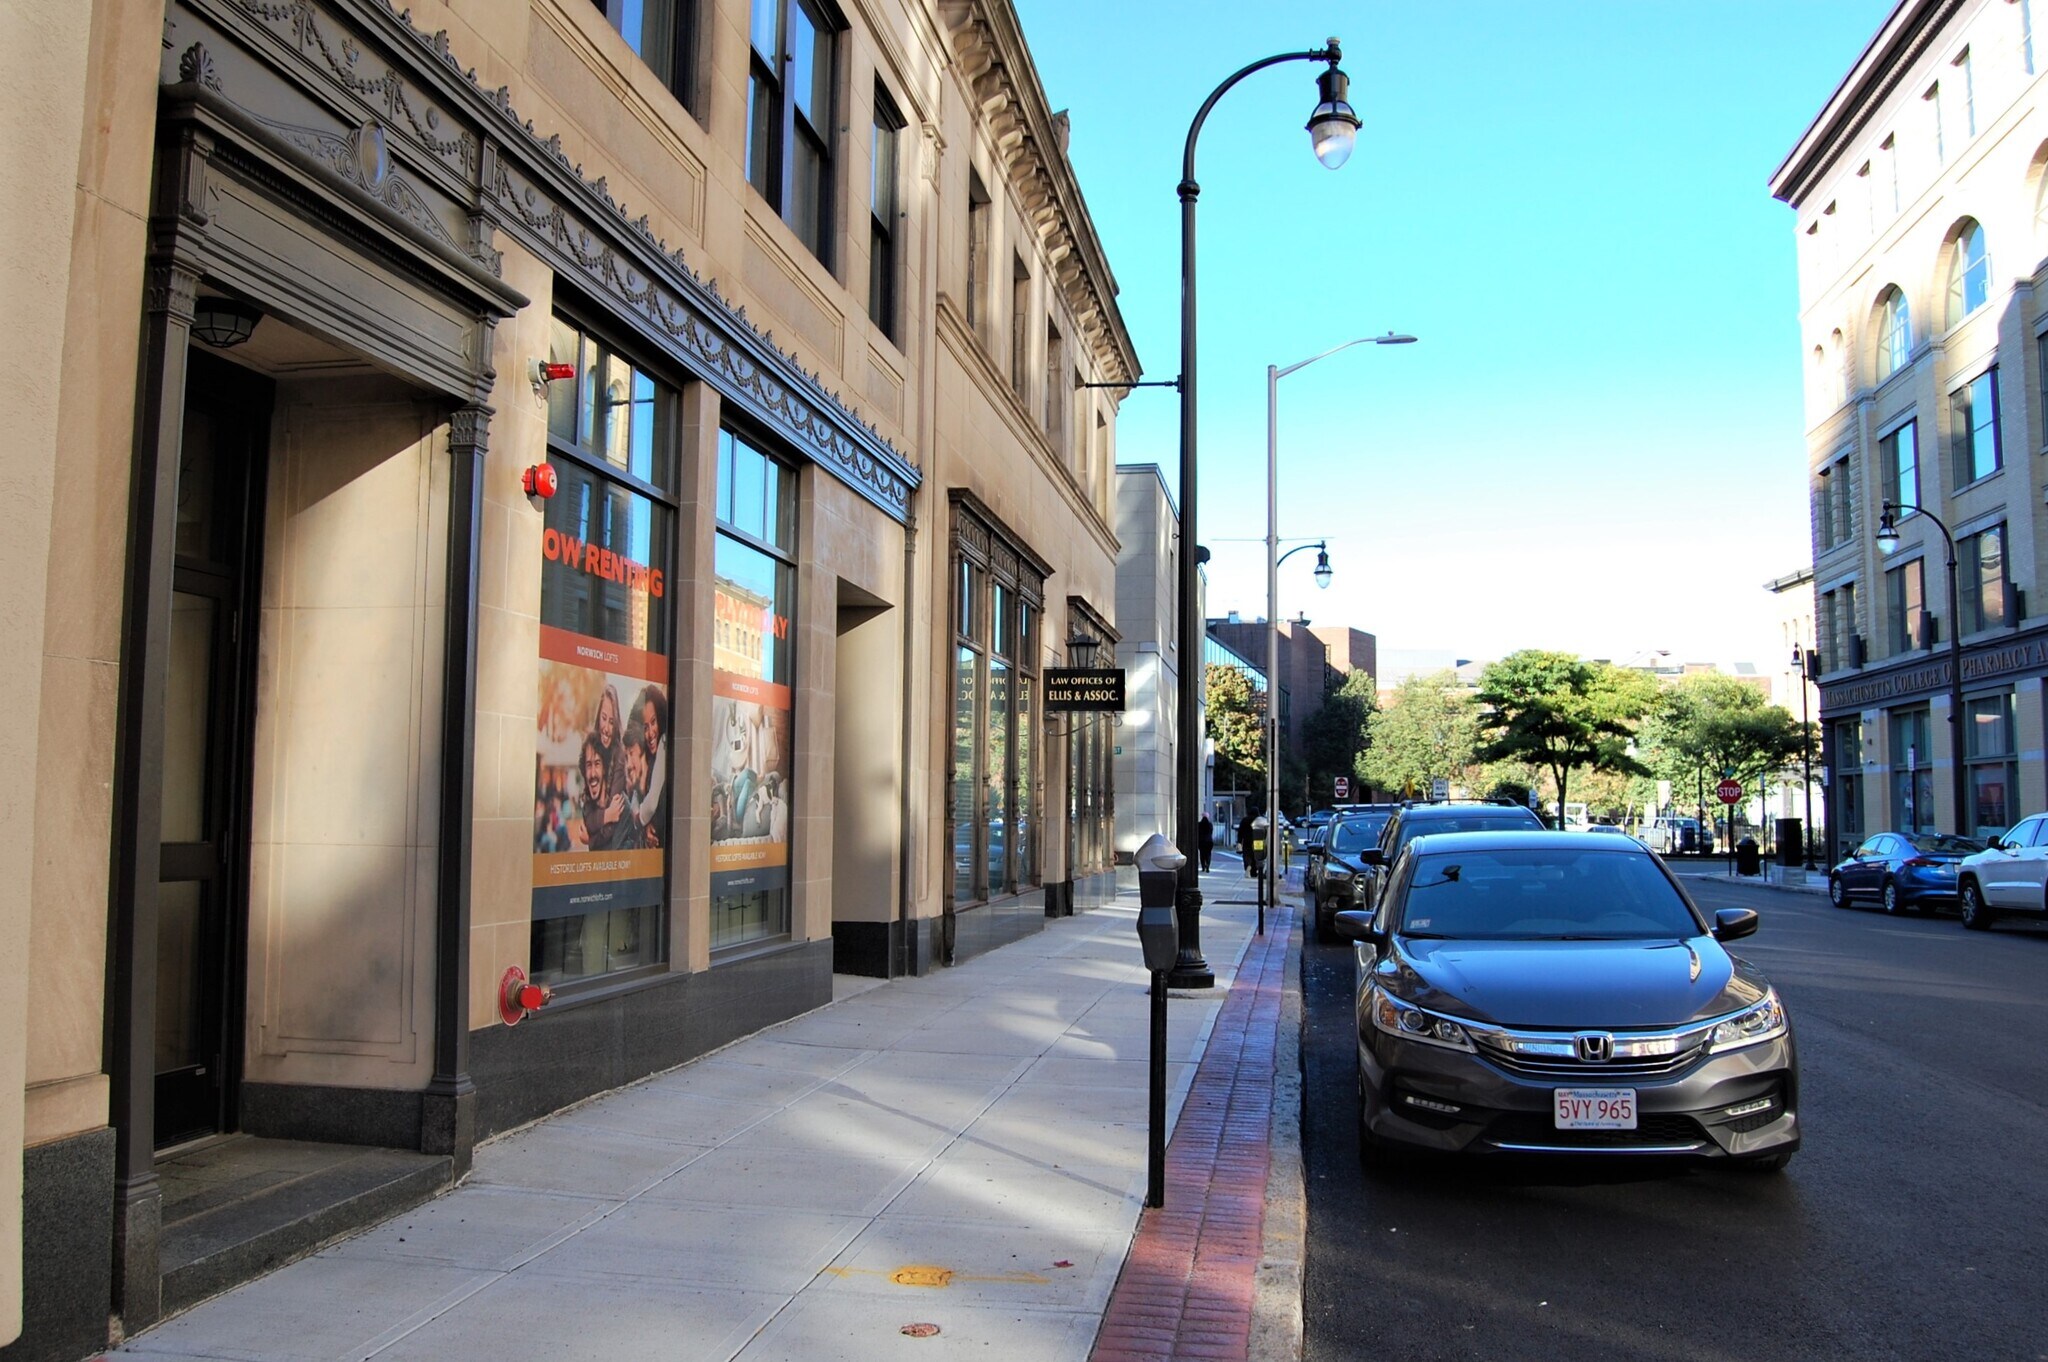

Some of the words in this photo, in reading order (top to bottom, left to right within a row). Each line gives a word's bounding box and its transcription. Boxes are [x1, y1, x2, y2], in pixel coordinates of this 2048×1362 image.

[585, 543, 663, 598] RENTING
[576, 645, 603, 660] NORWICH
[604, 650, 619, 663] LOFTS
[1051, 677, 1069, 685] LAW
[1071, 677, 1103, 685] OFFICES
[1105, 677, 1117, 685] OF
[1825, 680, 1892, 706] MASSACHUSETTS
[1893, 668, 1939, 692] COLLEGE
[1962, 645, 2031, 677] PHARMACY
[1049, 690, 1072, 701] ELLIS
[1074, 690, 1081, 701] &
[1083, 690, 1119, 701] ASSOC.
[1718, 787, 1741, 797] STOP
[550, 863, 575, 874] HISTORIC
[576, 862, 592, 873] LOFTS
[593, 860, 618, 871] AVAILABLE
[1560, 1099, 1592, 1119] 5VY
[1598, 1099, 1631, 1119] 965
